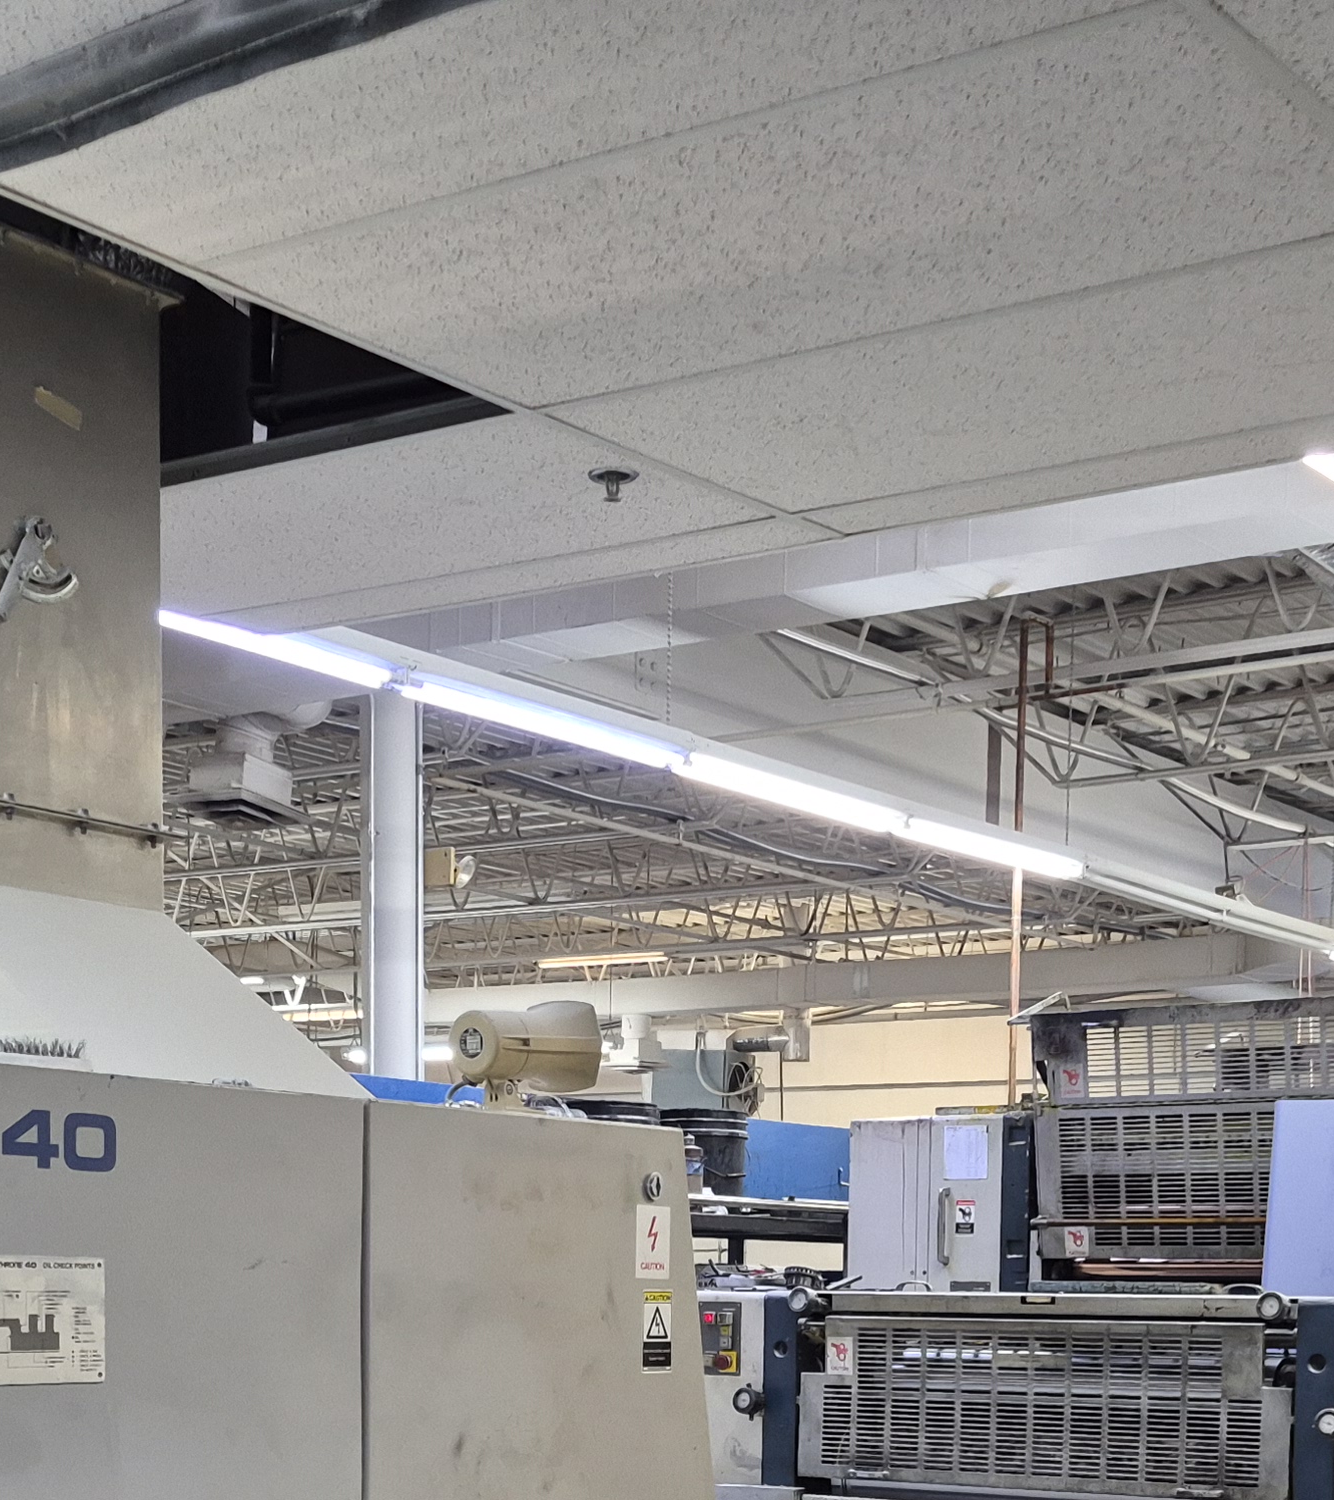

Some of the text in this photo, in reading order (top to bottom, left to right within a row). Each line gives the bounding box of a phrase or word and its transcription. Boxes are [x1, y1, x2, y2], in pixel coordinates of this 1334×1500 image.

[1, 1109, 117, 1173] 40
[640, 1262, 665, 1271] CAUTION
[649, 1294, 672, 1302] CAUTION
